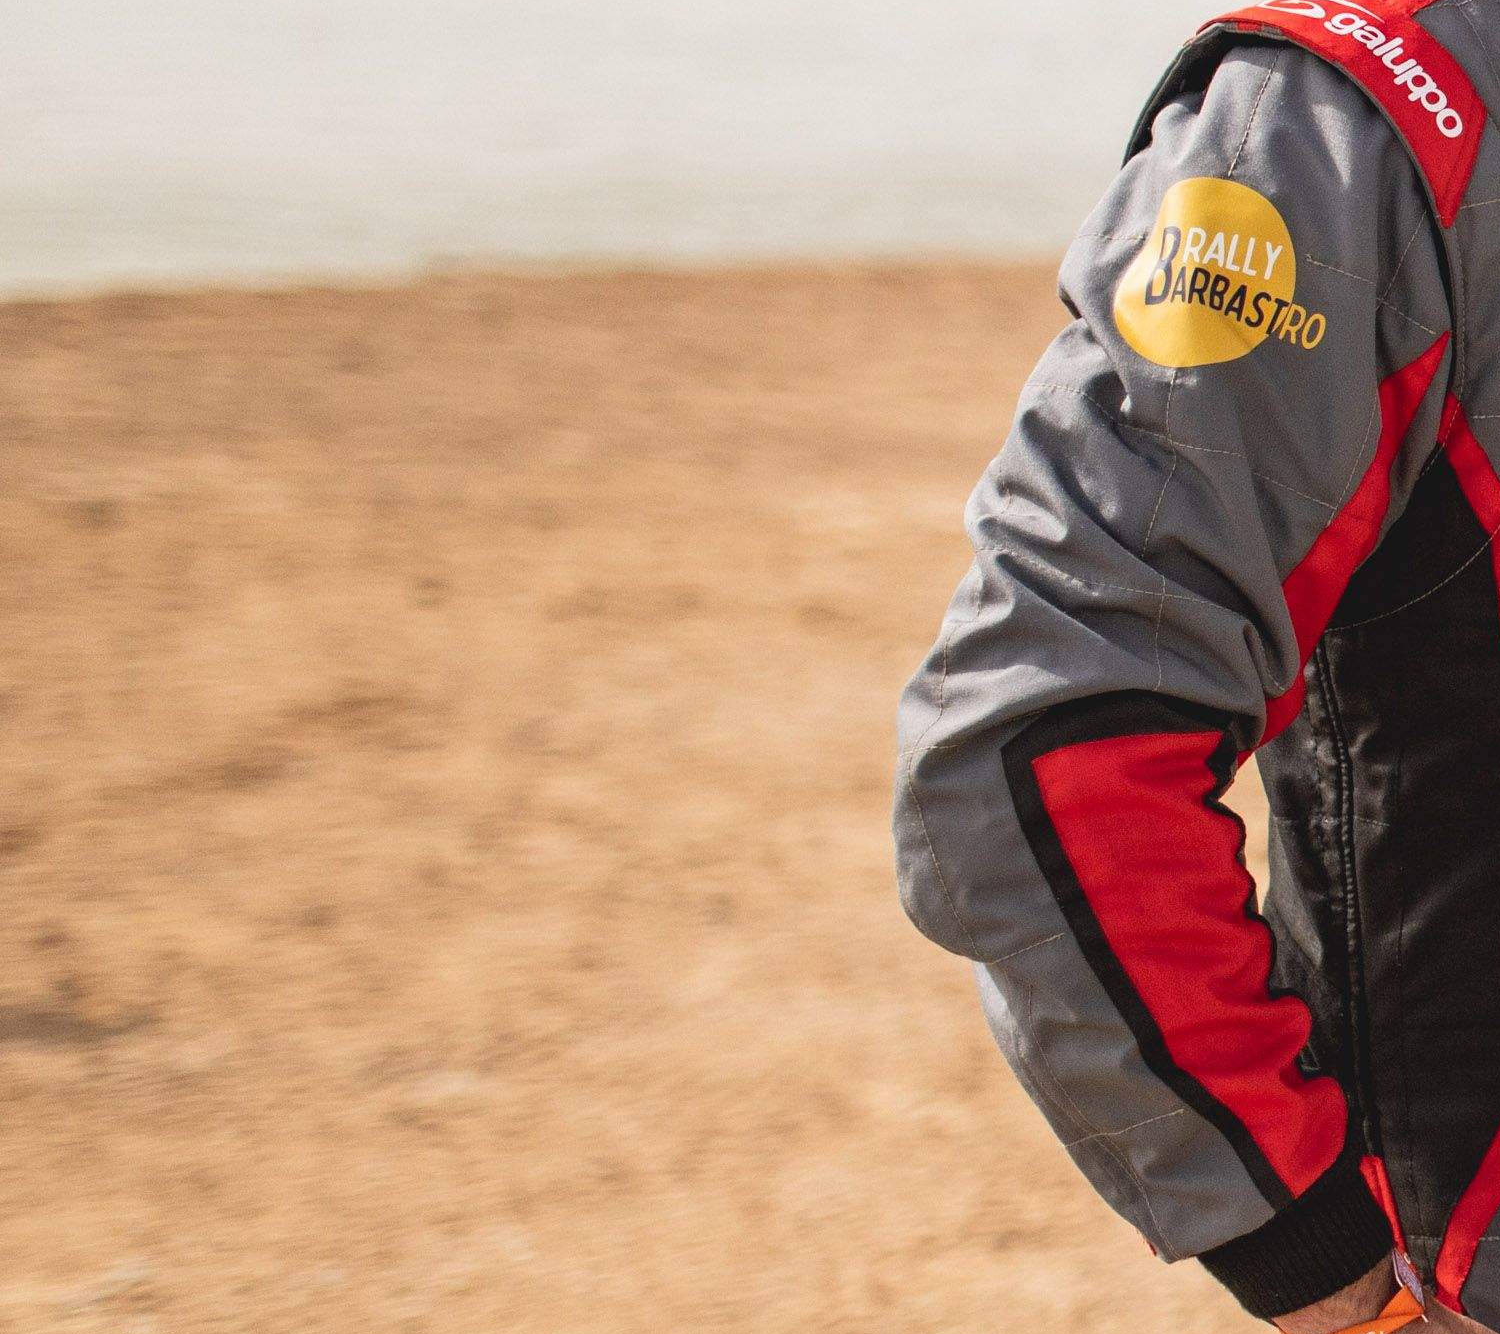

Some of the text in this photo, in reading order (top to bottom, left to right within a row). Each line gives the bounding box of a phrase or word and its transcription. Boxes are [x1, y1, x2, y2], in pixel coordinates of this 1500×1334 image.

[1324, 9, 1463, 138] galuppo
[1145, 226, 1326, 350] BARBASTRO
[1183, 227, 1283, 281] RALLY
